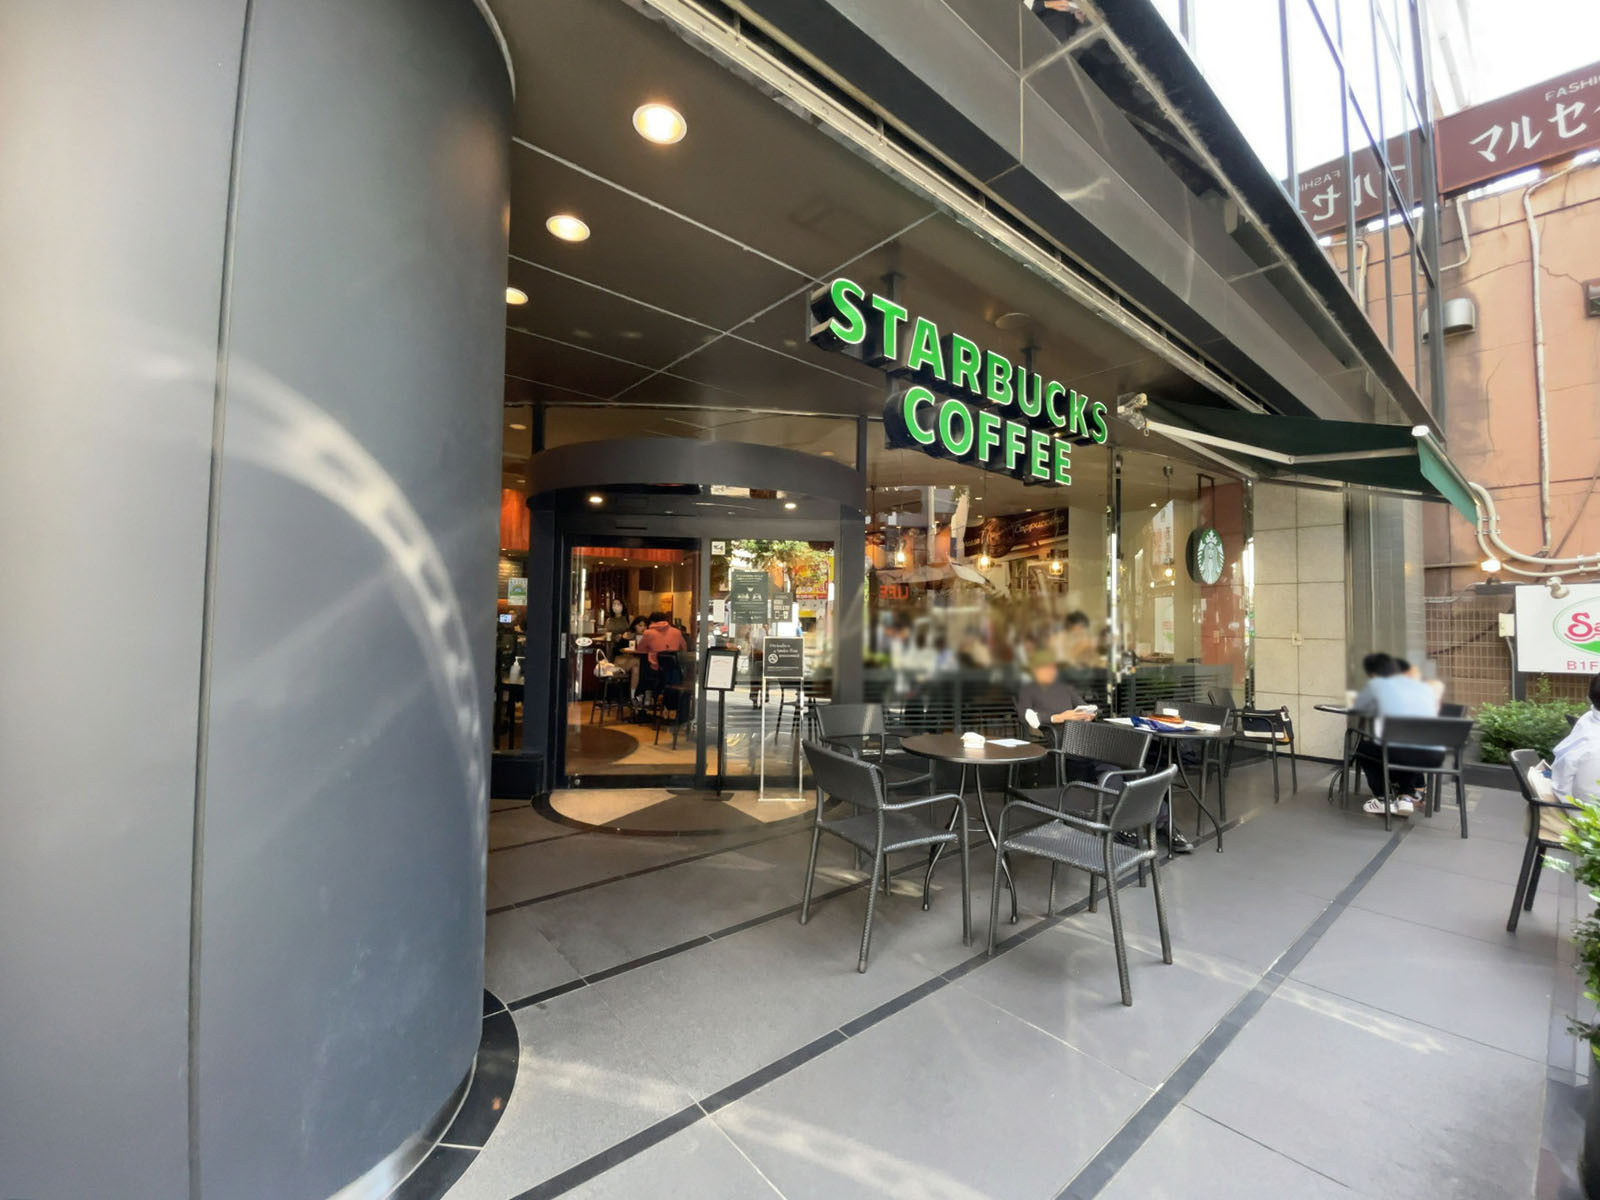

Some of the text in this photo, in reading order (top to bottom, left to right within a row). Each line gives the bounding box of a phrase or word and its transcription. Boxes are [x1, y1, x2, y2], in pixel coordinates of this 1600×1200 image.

[1545, 75, 1600, 101] FASHI
[1468, 101, 1600, 162] マルセ
[829, 277, 1108, 444] STARBUCKS
[903, 386, 1071, 486] COFFEE
[1567, 660, 1598, 671] B1F
